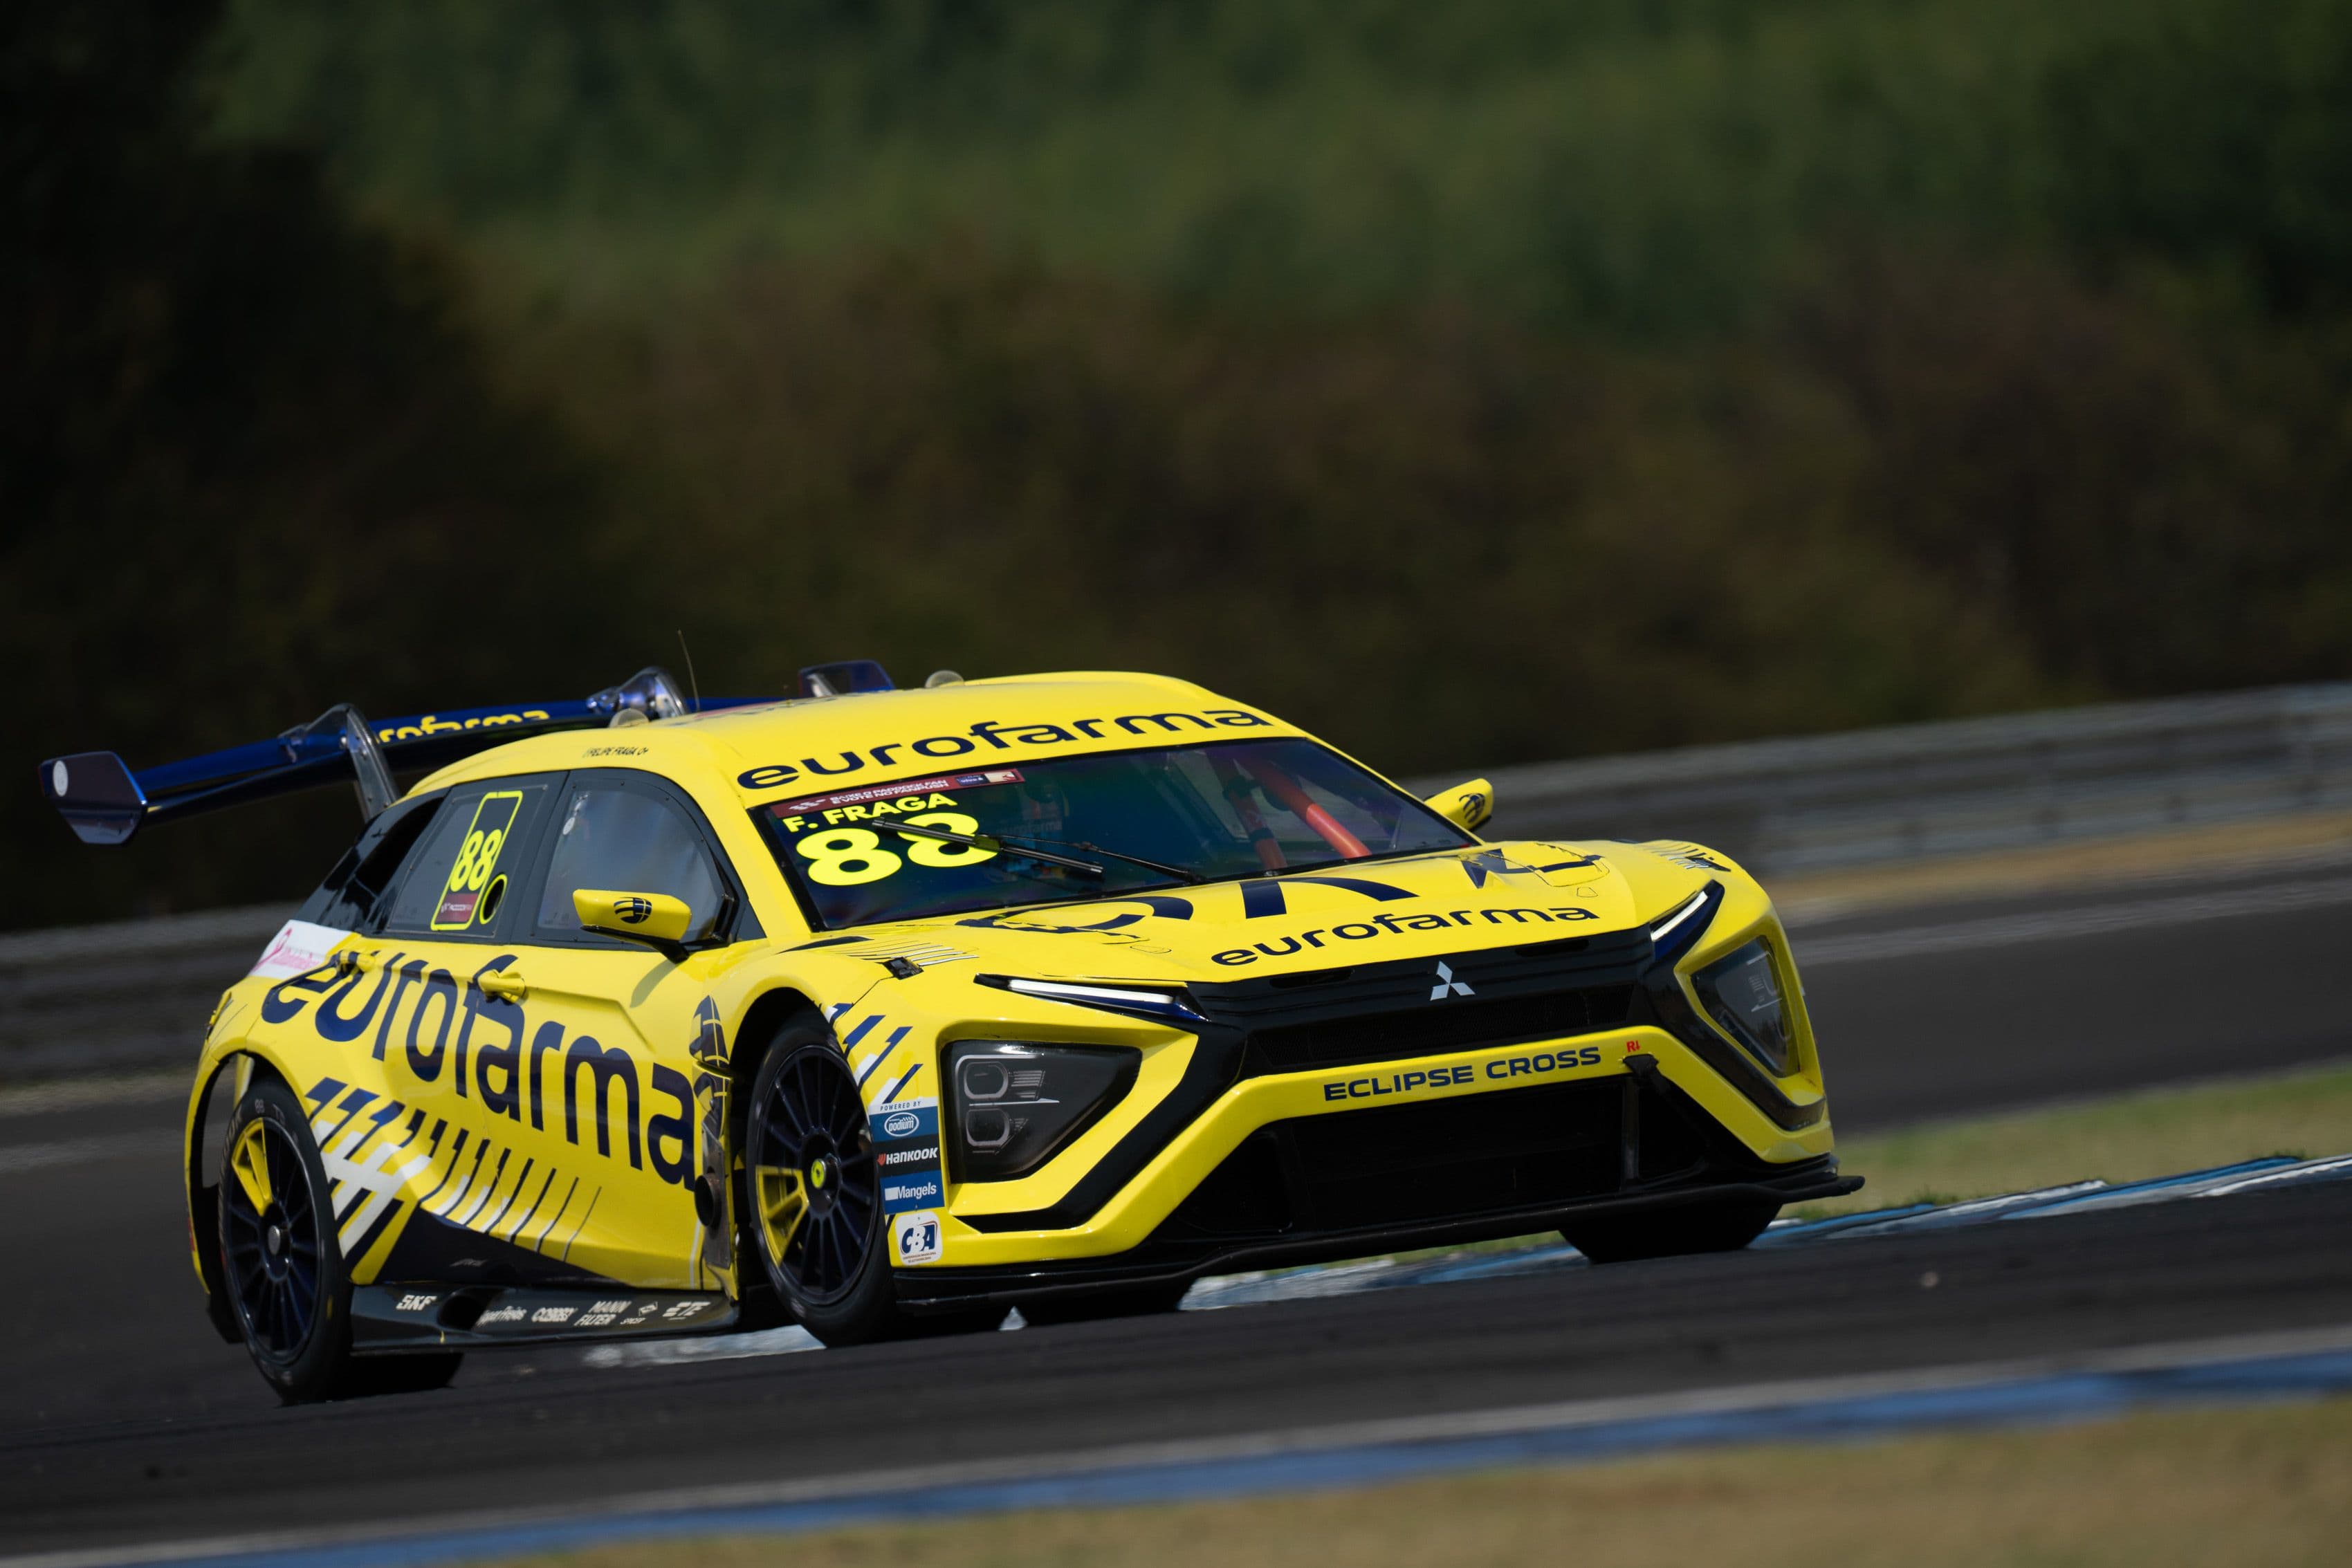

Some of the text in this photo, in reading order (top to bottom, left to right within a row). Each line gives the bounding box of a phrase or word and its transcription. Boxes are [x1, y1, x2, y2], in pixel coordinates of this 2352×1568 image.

[737, 710, 1274, 790] eurofarma
[841, 794, 873, 802] VOTE
[894, 782, 950, 794] FANPUSH
[872, 783, 925, 795] PADDOCK
[783, 793, 957, 833] F. FRAGA
[450, 829, 502, 892] 88
[796, 812, 1000, 886] 88
[1211, 907, 1600, 966] eurofarma
[261, 950, 695, 1192] eurofarma
[1324, 1046, 1601, 1101] ECLIPSE CROSS
[880, 1103, 910, 1112] POWERED
[888, 1118, 914, 1132] podium
[898, 1181, 937, 1199] Mangels
[901, 1224, 935, 1254] CBA
[396, 1295, 438, 1311] SKF
[588, 1301, 633, 1313] MANN
[573, 1314, 617, 1327] FILTER
